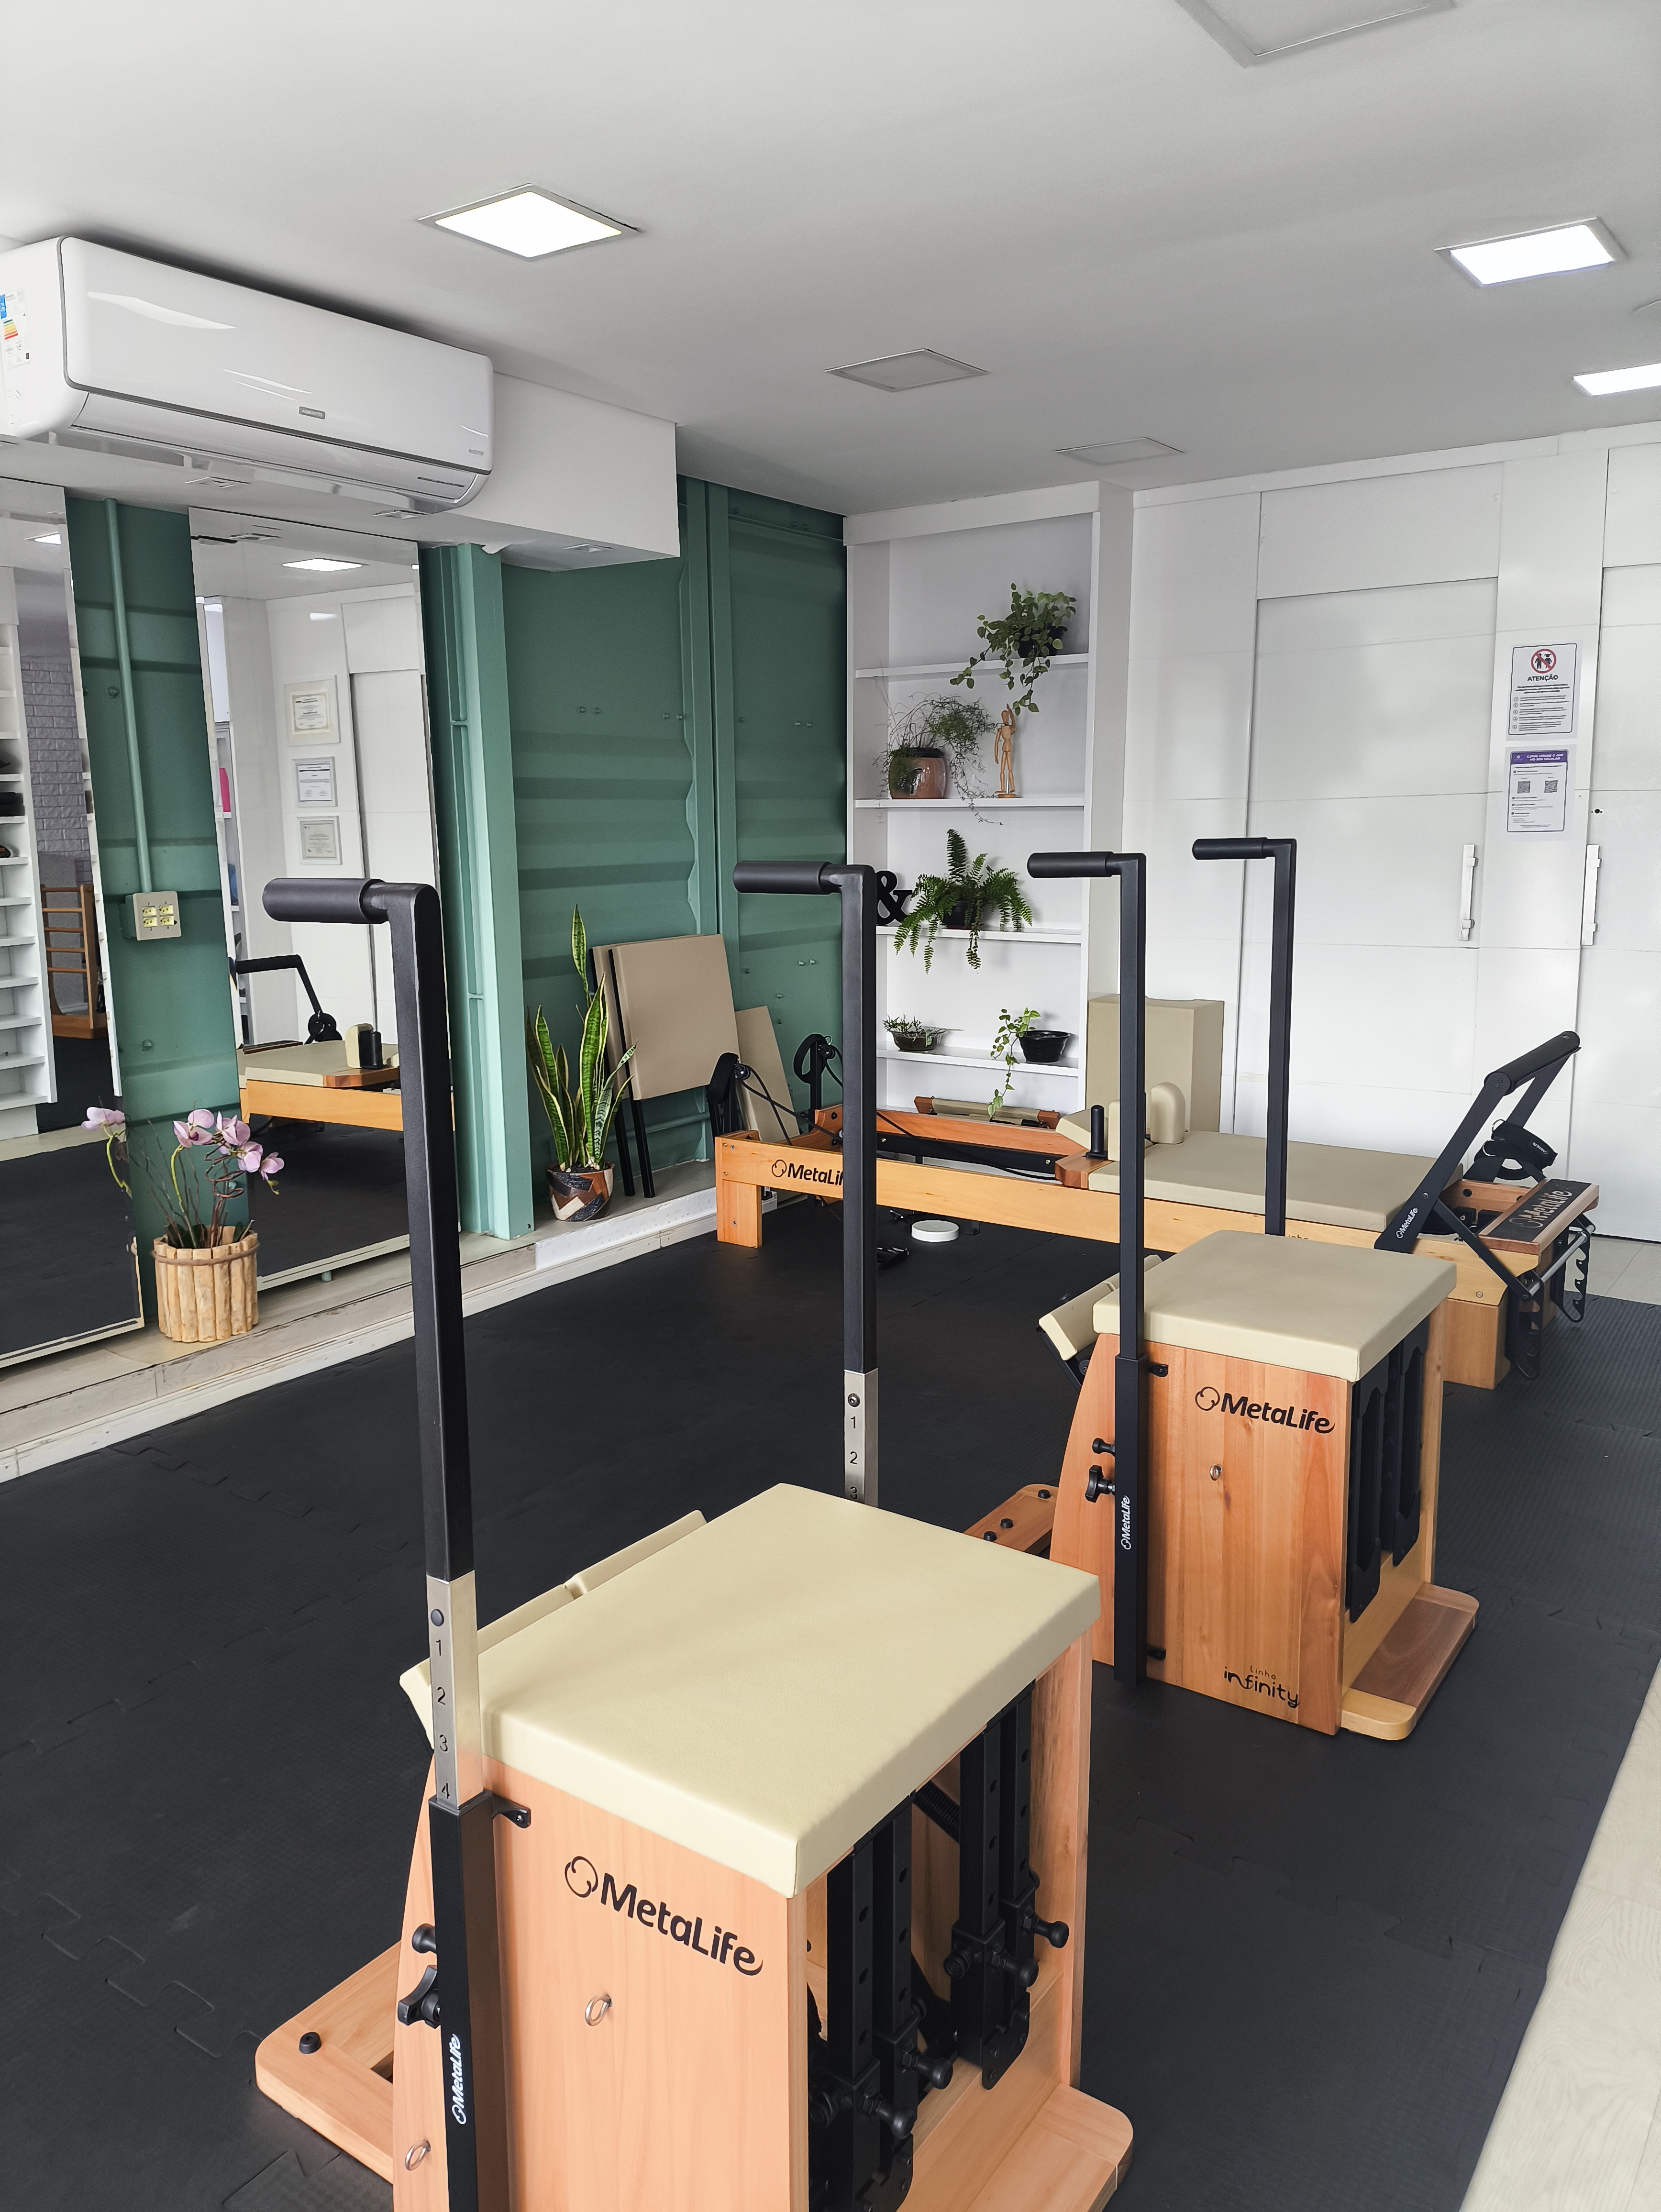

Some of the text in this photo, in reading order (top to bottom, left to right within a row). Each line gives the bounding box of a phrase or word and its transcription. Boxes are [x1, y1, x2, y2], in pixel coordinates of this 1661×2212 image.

[1518, 1191, 1572, 1221] MetaLife
[1399, 1207, 1418, 1234] MetaLife
[851, 1416, 856, 1429] 1
[1220, 1393, 1335, 1434] MetaLife
[850, 1451, 858, 1465] 2
[850, 1486, 858, 1500] 3
[1121, 1495, 1130, 1540] MetaLife
[436, 1639, 441, 1656] 1
[437, 1687, 446, 1705] 2
[1224, 1666, 1300, 1709] infinity
[439, 1734, 448, 1752] 3
[441, 1782, 450, 1799] 4
[601, 1873, 764, 1976] MetaLife
[449, 2034, 465, 2109] MetaLife
